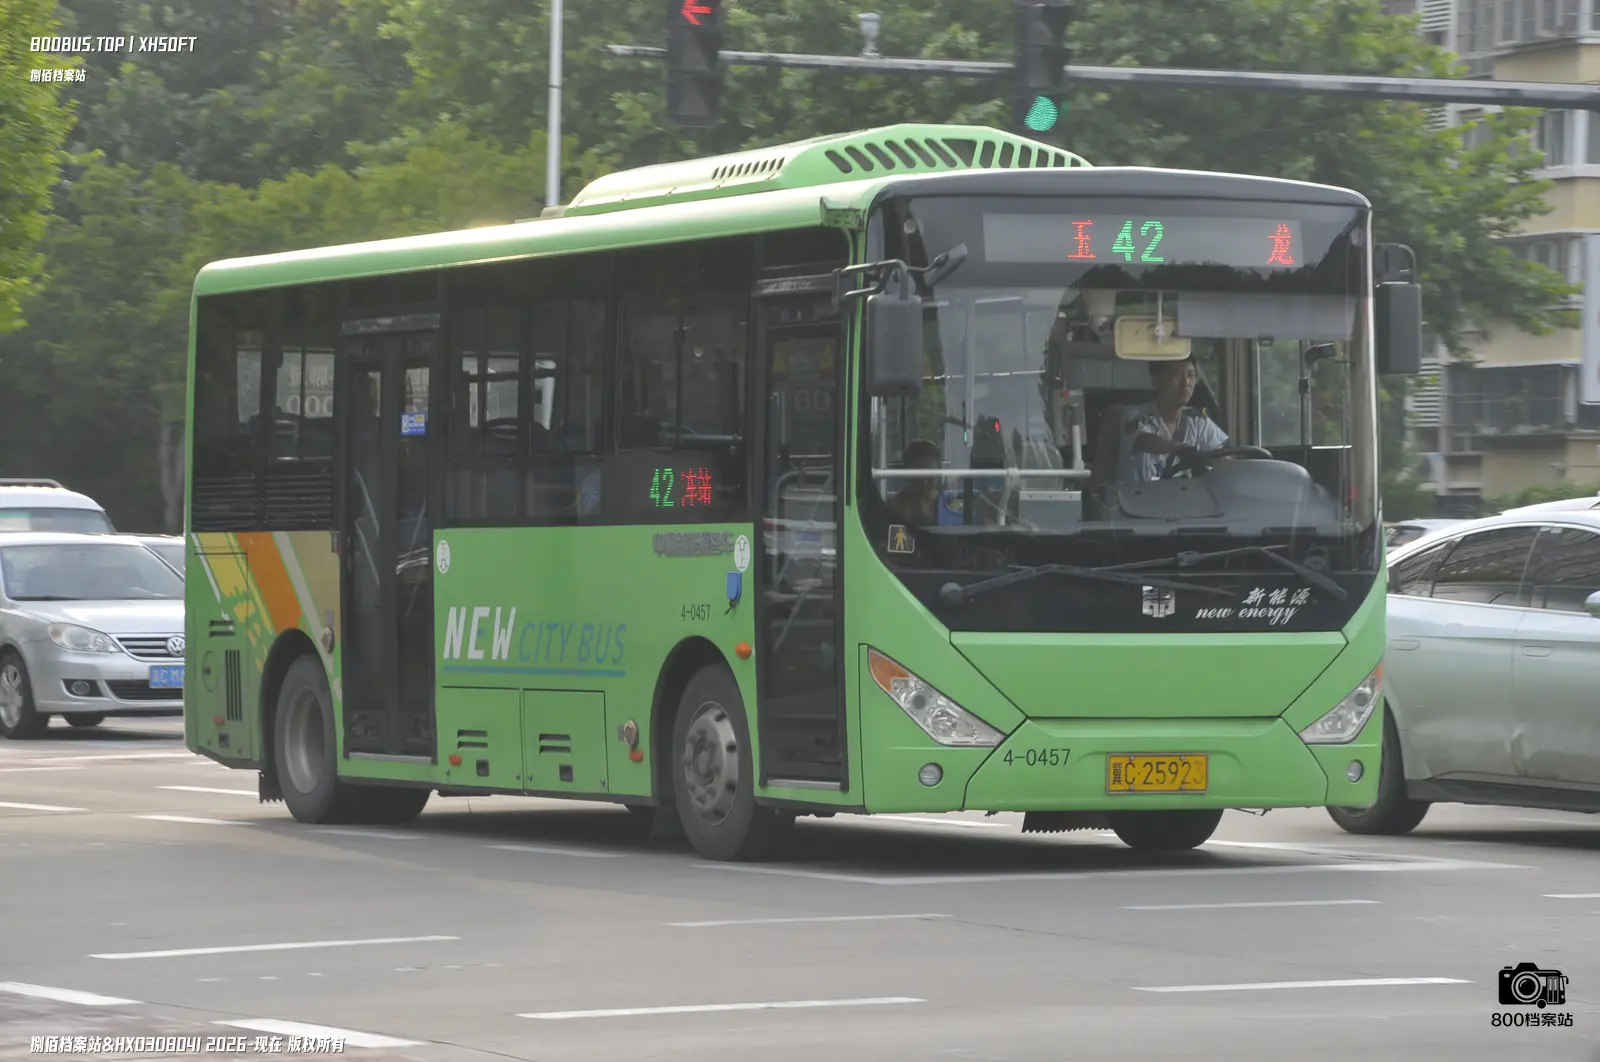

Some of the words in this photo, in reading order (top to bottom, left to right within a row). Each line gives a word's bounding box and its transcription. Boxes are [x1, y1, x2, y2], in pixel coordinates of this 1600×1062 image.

[1111, 219, 1165, 263] 42
[649, 467, 675, 508] 42
[1241, 586, 1312, 608] 新能源
[680, 604, 711, 621] 4-0457
[1195, 607, 1236, 620] new
[1238, 606, 1300, 626] energy
[443, 606, 517, 660] NEW
[519, 622, 574, 663] CITY
[577, 622, 628, 665] BUS
[1002, 748, 1071, 767] 4-0457
